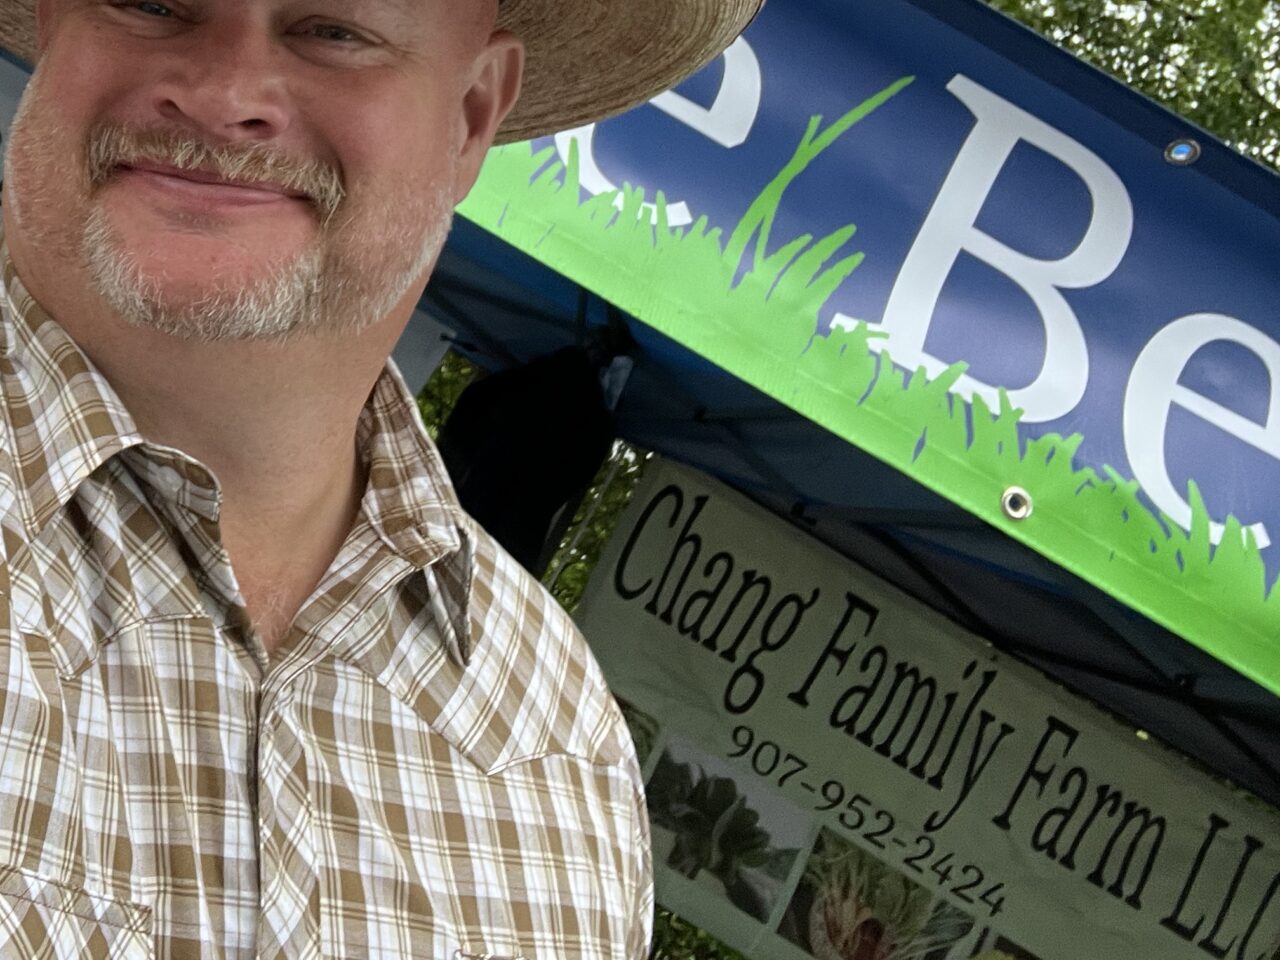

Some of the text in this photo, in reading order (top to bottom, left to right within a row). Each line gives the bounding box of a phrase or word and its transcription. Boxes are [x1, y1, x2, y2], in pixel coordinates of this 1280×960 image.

[612, 484, 818, 714] Chang
[787, 592, 1015, 832] Family
[992, 715, 1167, 911] Farm
[728, 725, 1006, 917] 907-952-2424
